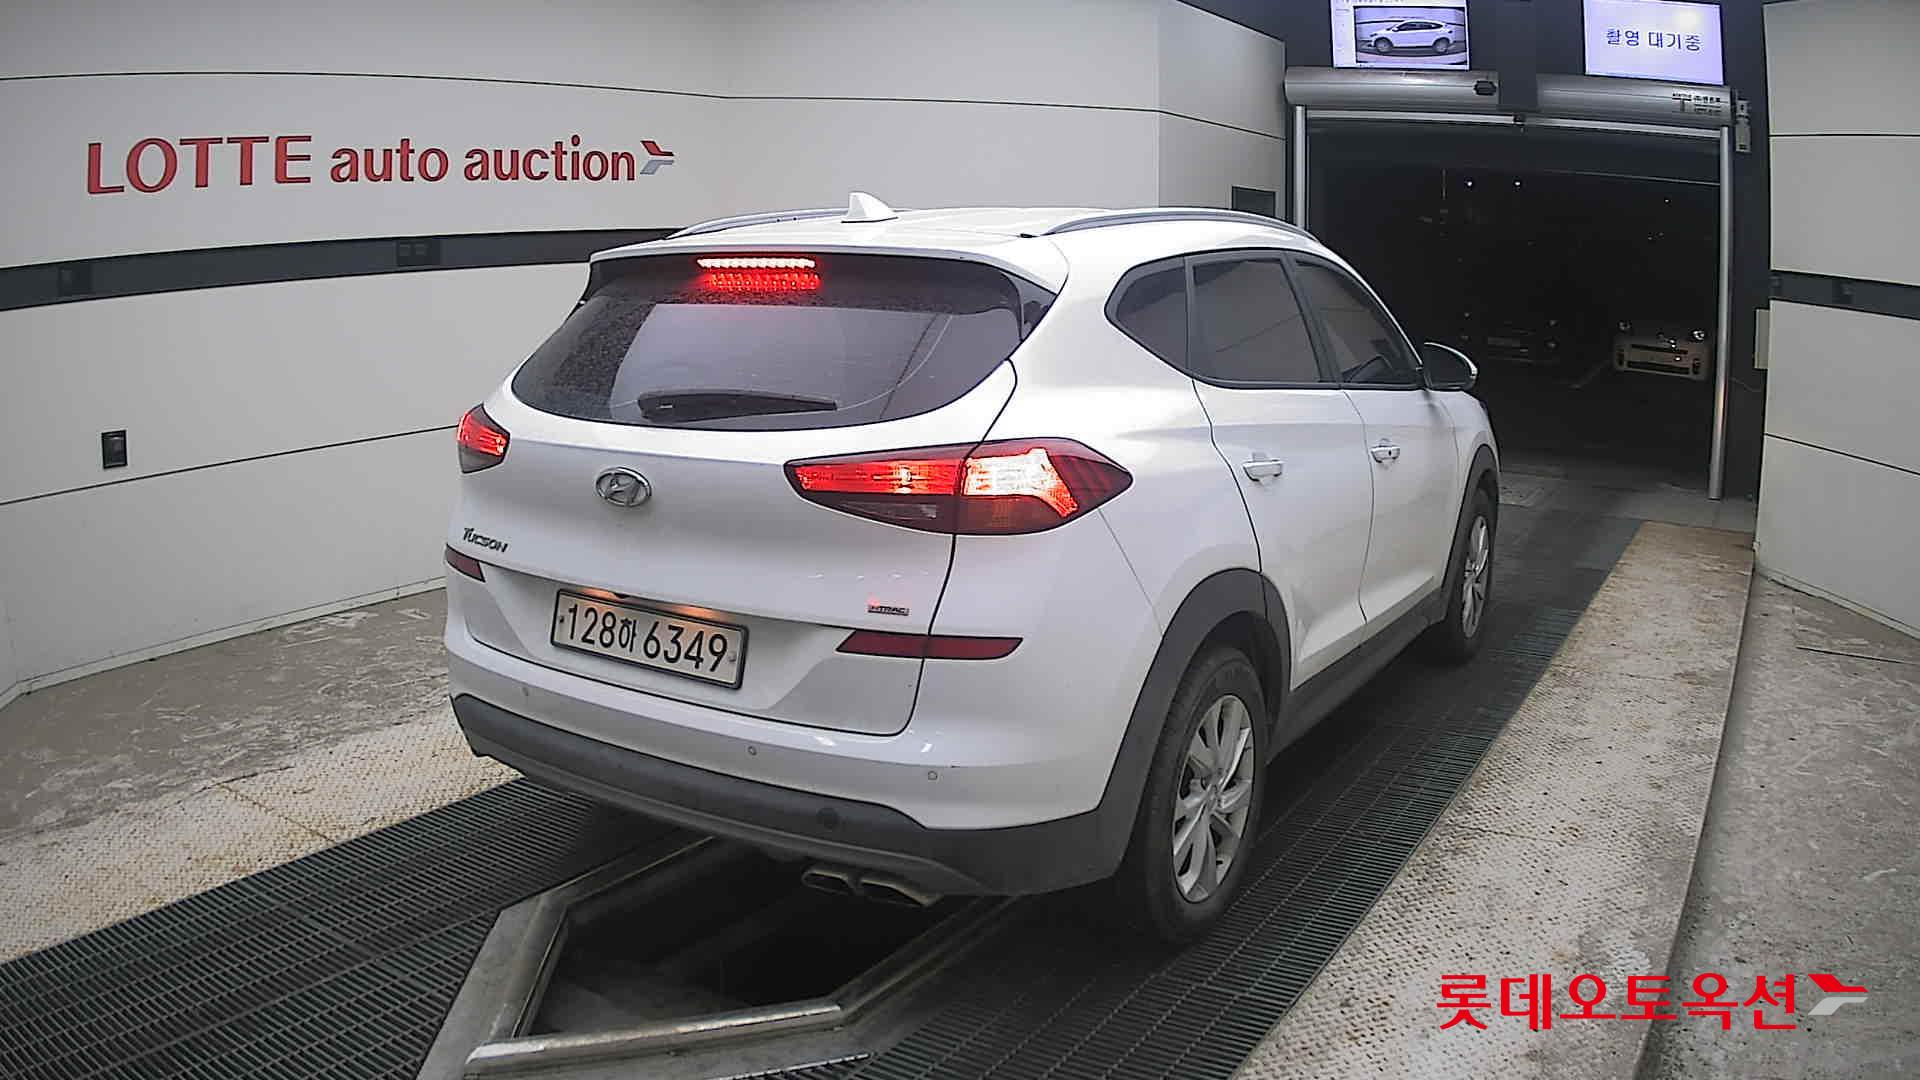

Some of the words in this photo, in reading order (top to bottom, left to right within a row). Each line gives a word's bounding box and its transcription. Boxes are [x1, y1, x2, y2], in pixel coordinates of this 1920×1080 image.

[1606, 28, 1639, 46] 촬영
[1648, 32, 1700, 51] 대기중
[87, 136, 312, 194] LOTTE
[330, 138, 448, 183] auto
[464, 135, 636, 182] auction
